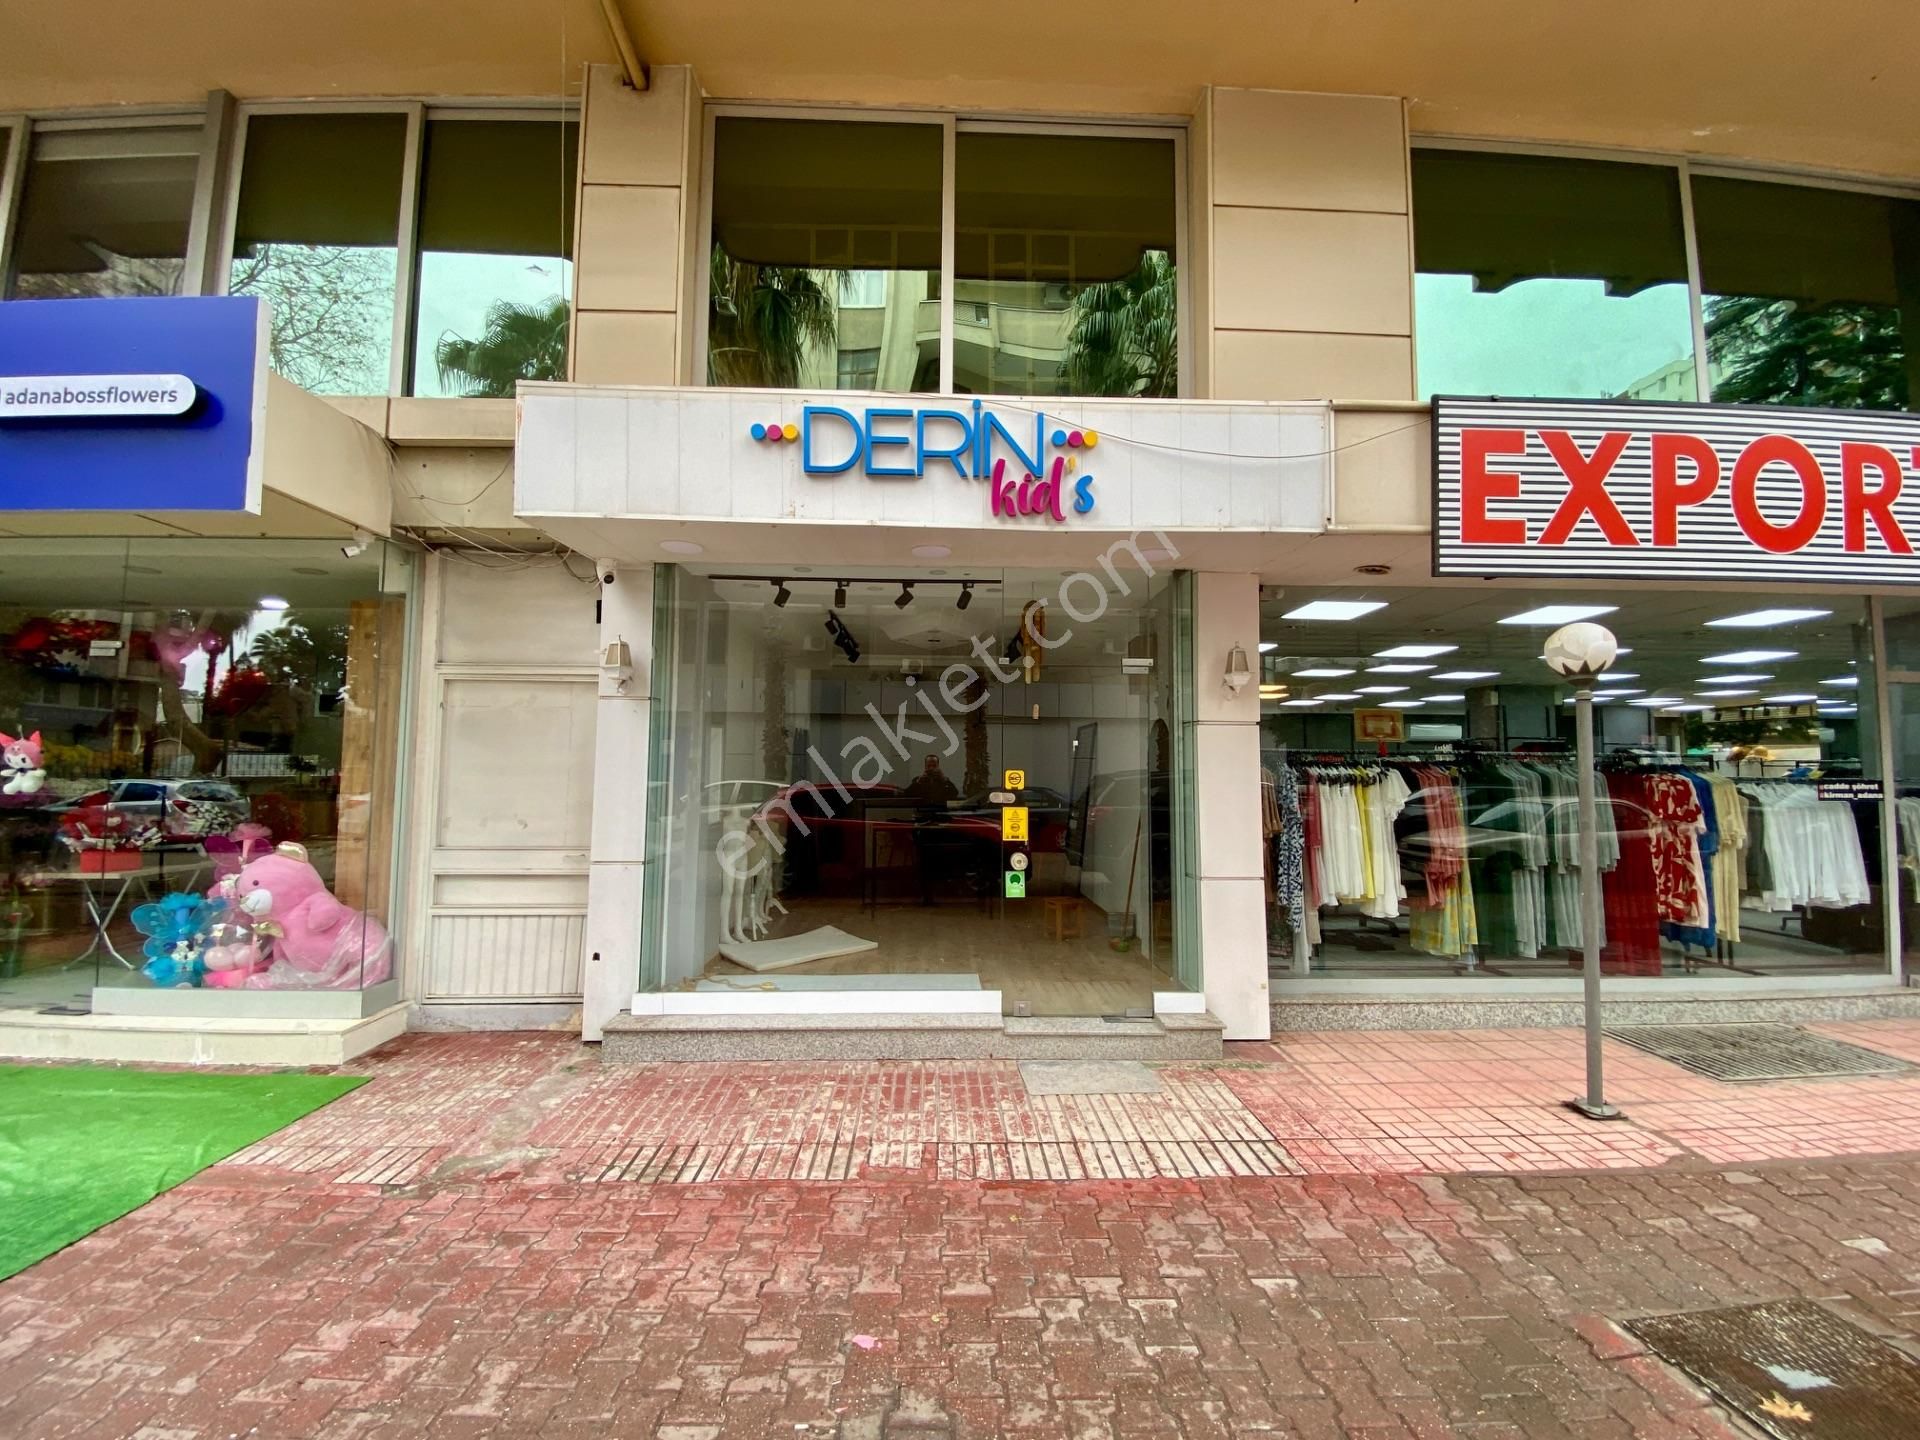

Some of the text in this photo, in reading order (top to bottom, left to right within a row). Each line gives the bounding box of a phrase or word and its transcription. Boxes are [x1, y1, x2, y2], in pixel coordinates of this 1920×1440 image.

[5, 386, 178, 405] adanabossflowers
[990, 455, 1096, 521] kid's
[1460, 429, 1920, 554] EXPOR
